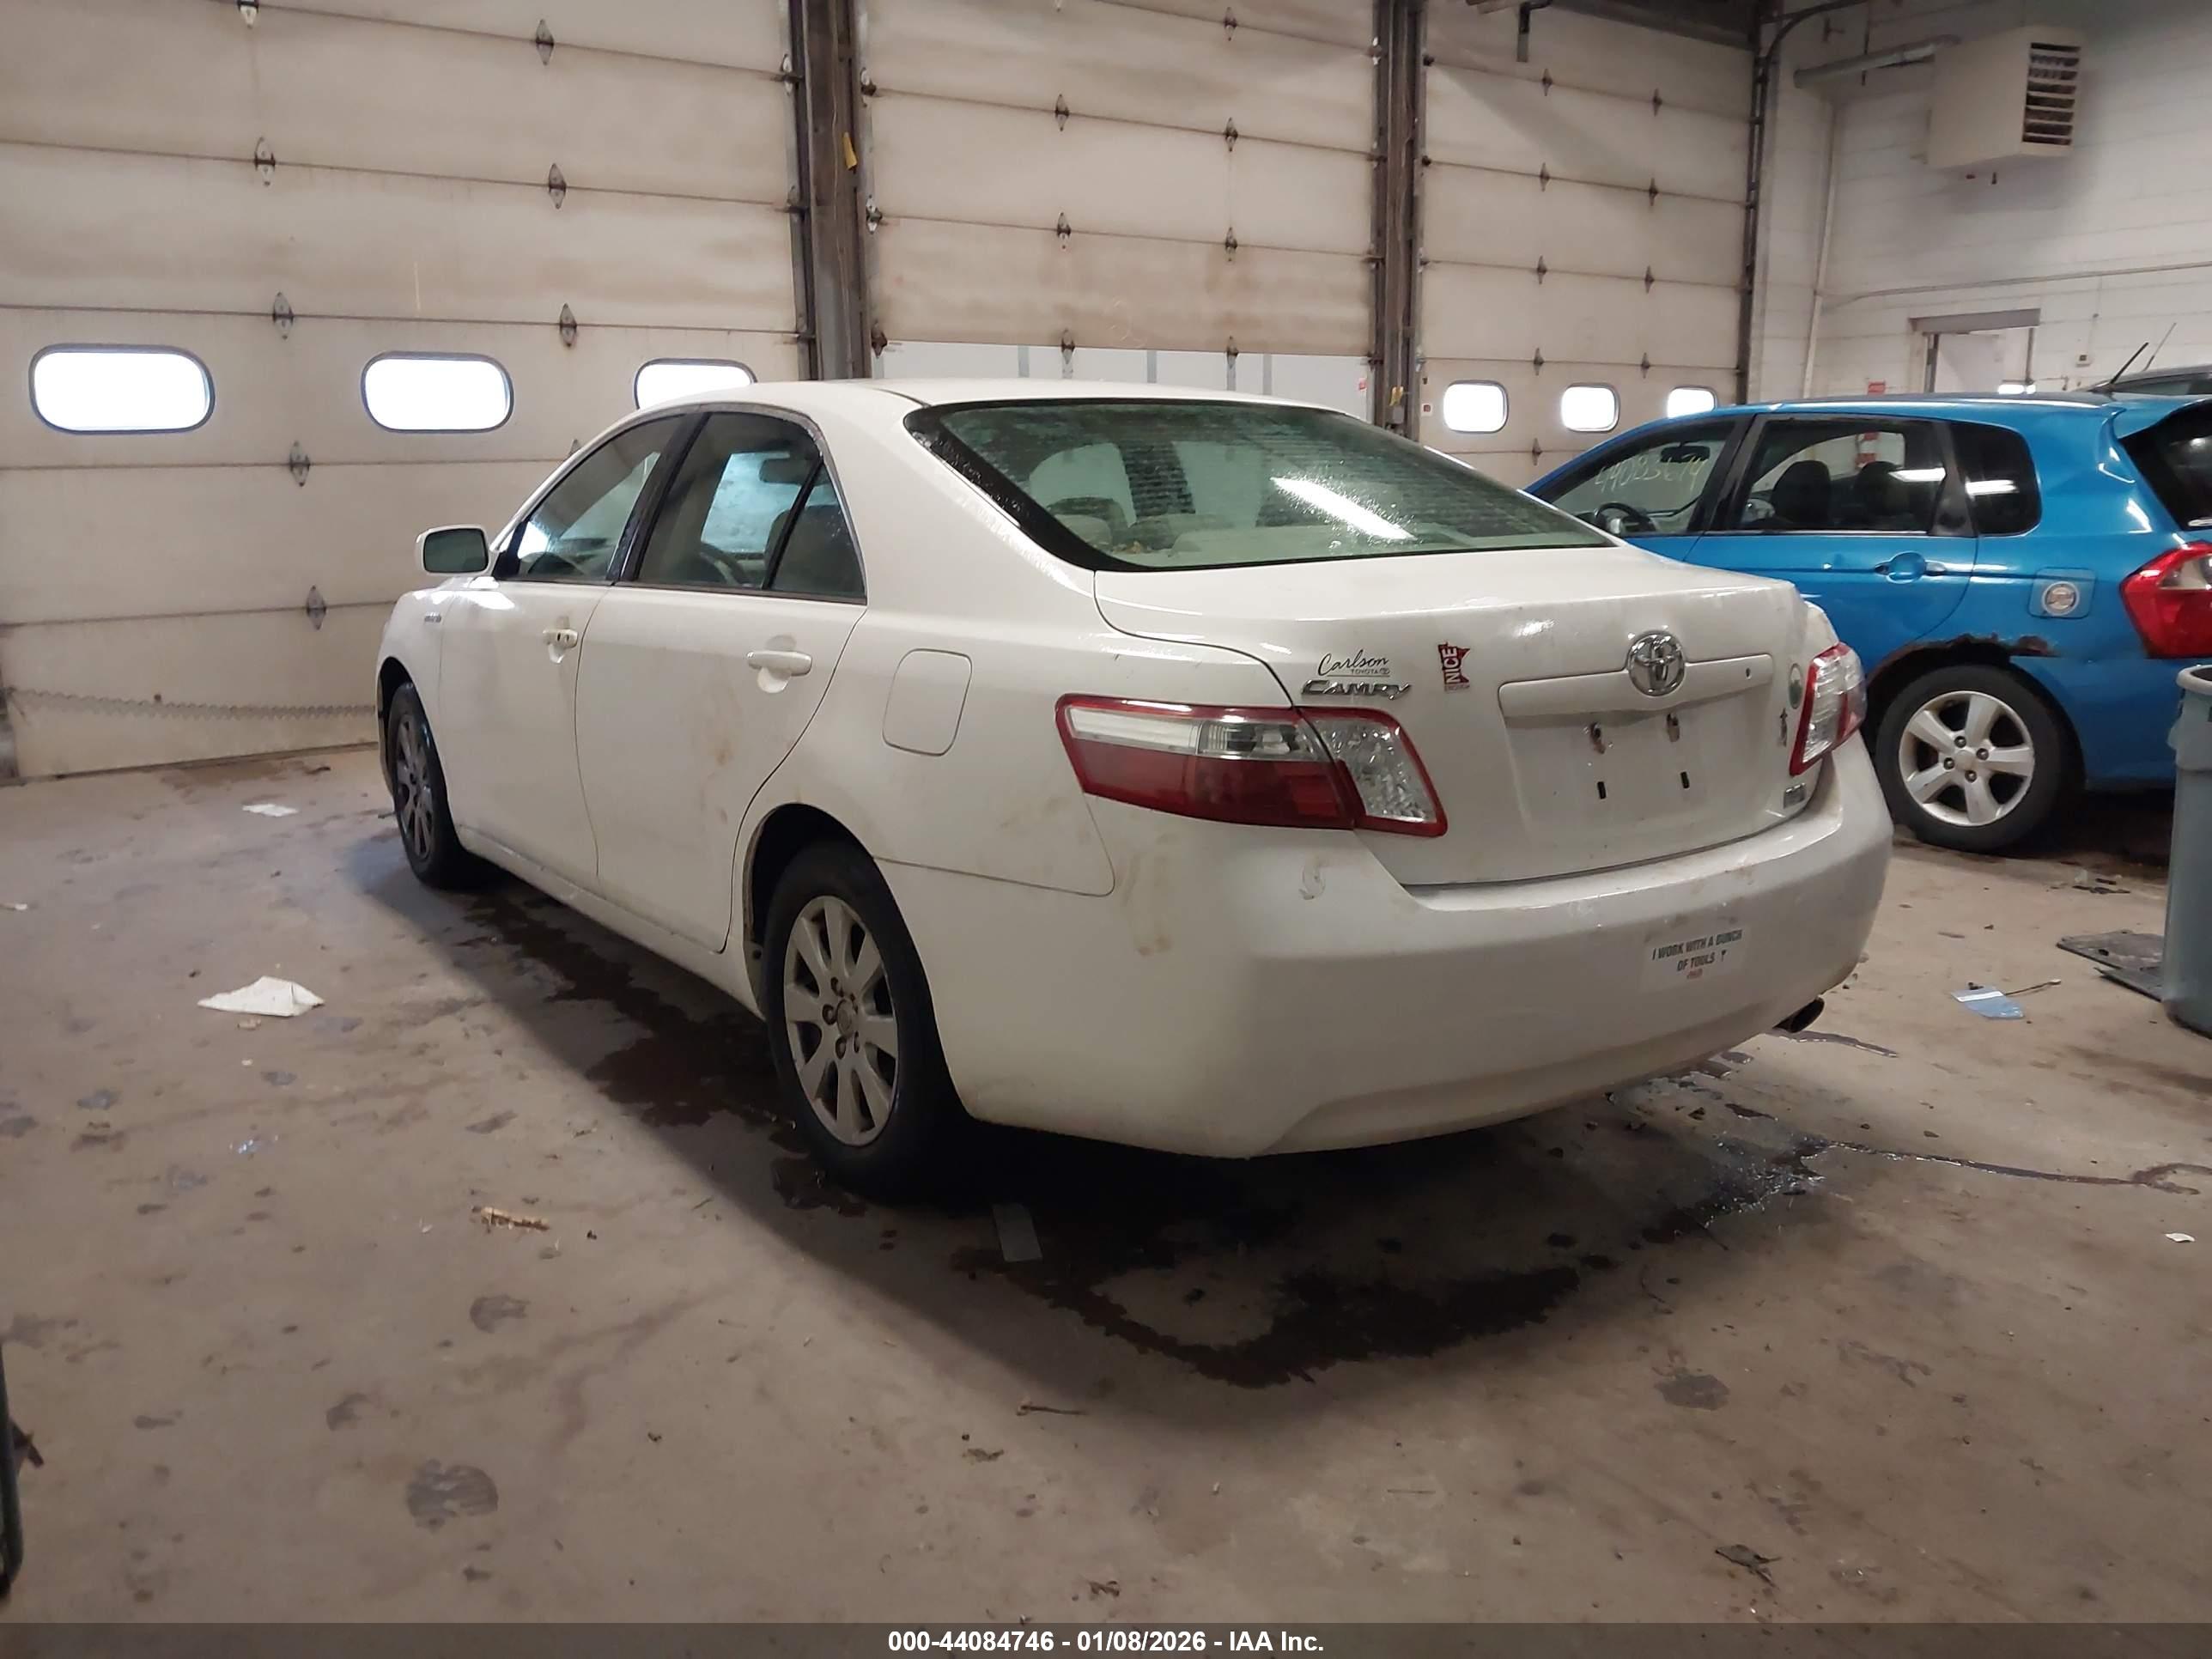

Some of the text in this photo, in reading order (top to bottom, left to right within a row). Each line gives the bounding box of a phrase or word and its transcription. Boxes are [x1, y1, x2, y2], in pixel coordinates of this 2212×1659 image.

[1317, 649, 1389, 677] Carlson
[1442, 647, 1462, 684] NICE
[1657, 942, 1685, 959] WORK
[1686, 937, 1707, 953] WITH
[1707, 935, 1714, 948] A
[1676, 951, 1716, 972] OF TOOLS
